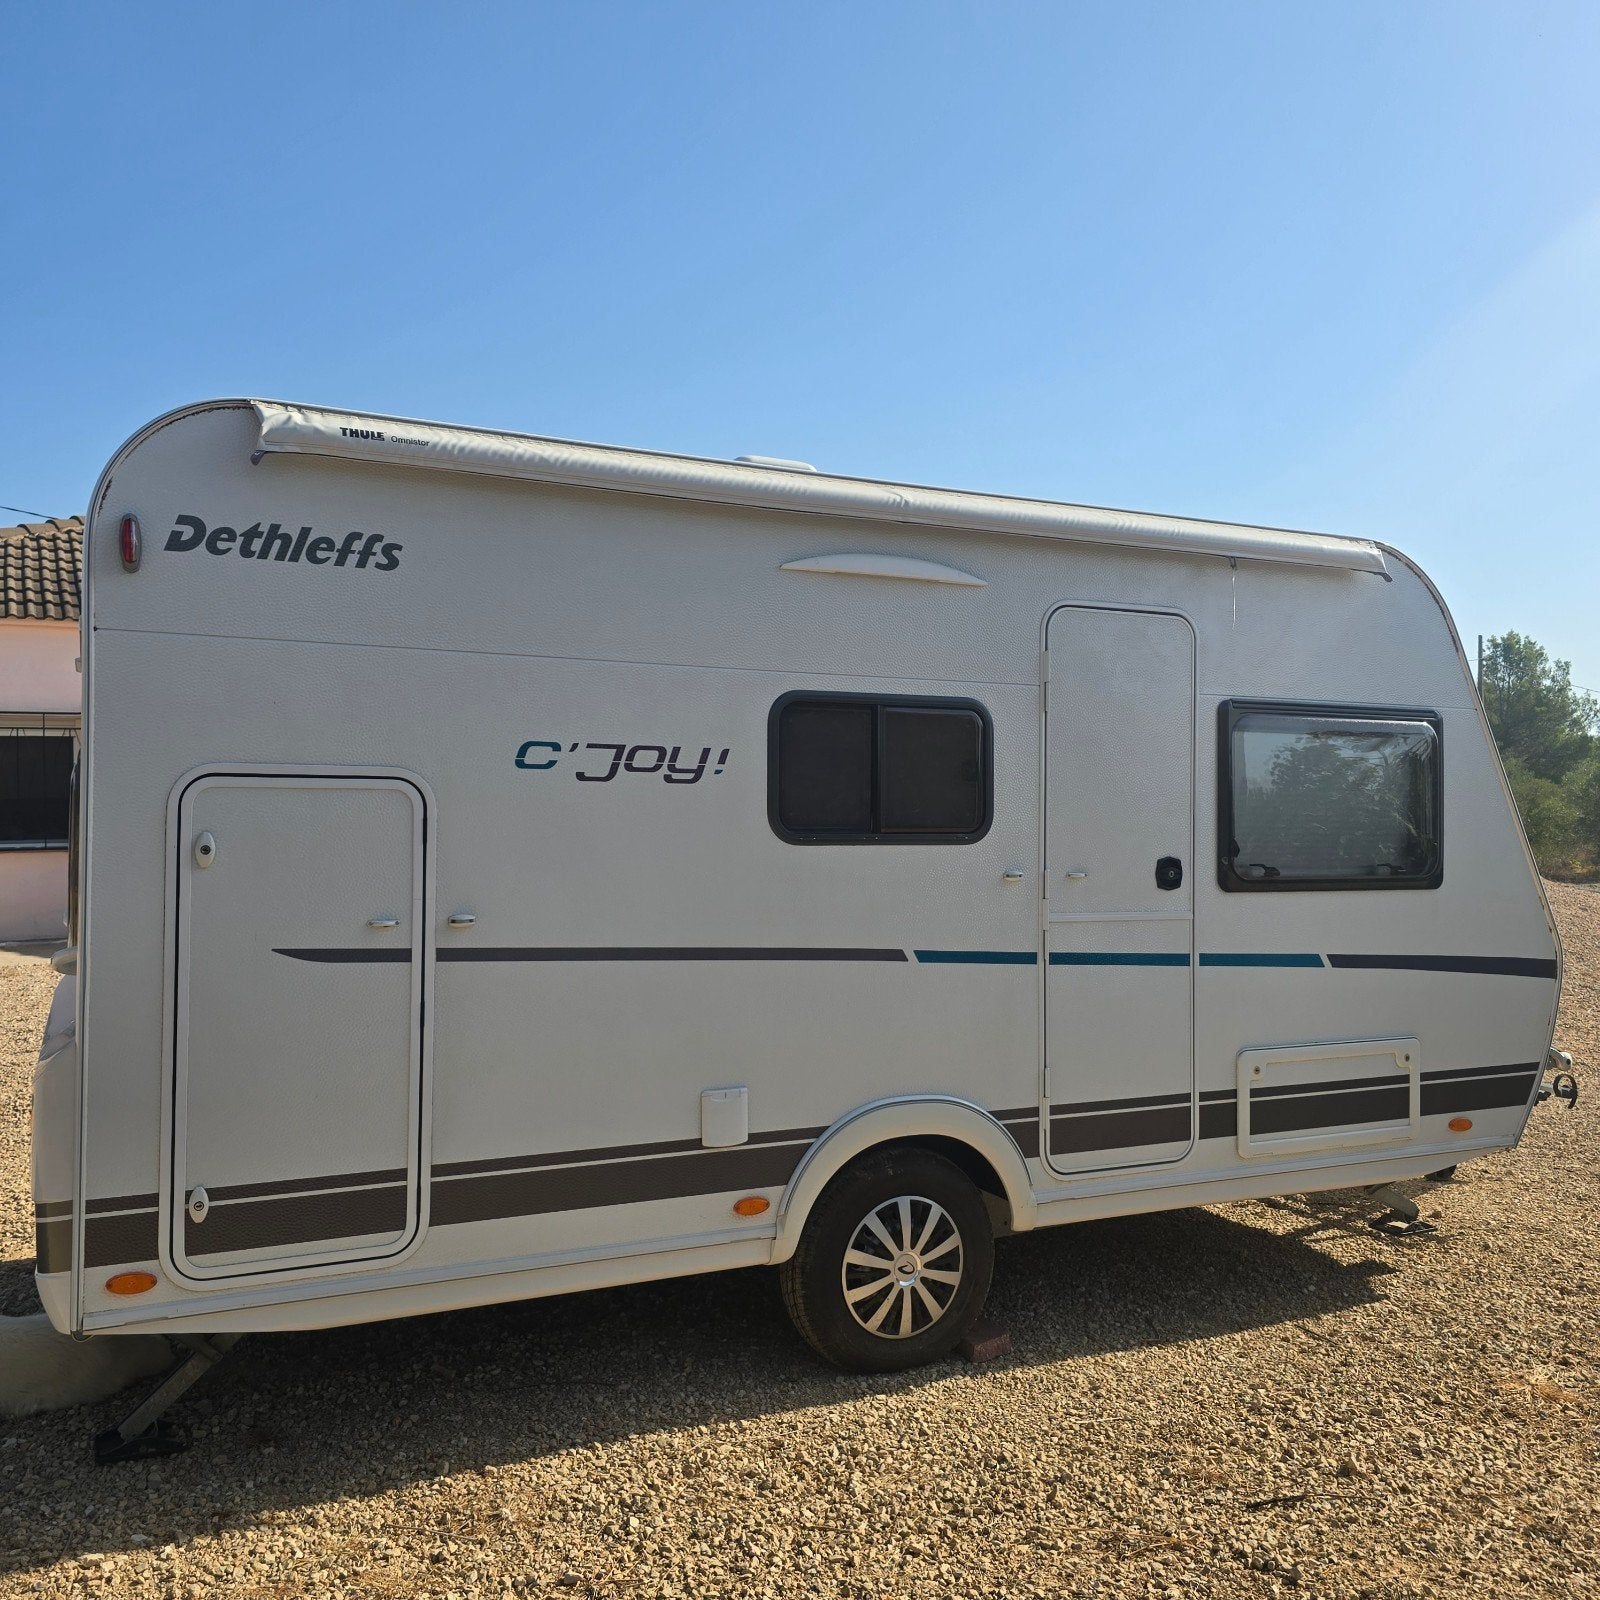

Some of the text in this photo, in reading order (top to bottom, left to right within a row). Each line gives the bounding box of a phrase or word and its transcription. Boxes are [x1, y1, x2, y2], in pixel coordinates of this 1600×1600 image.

[339, 427, 430, 447] THULE Omnistor
[163, 514, 404, 571] Dethleffs
